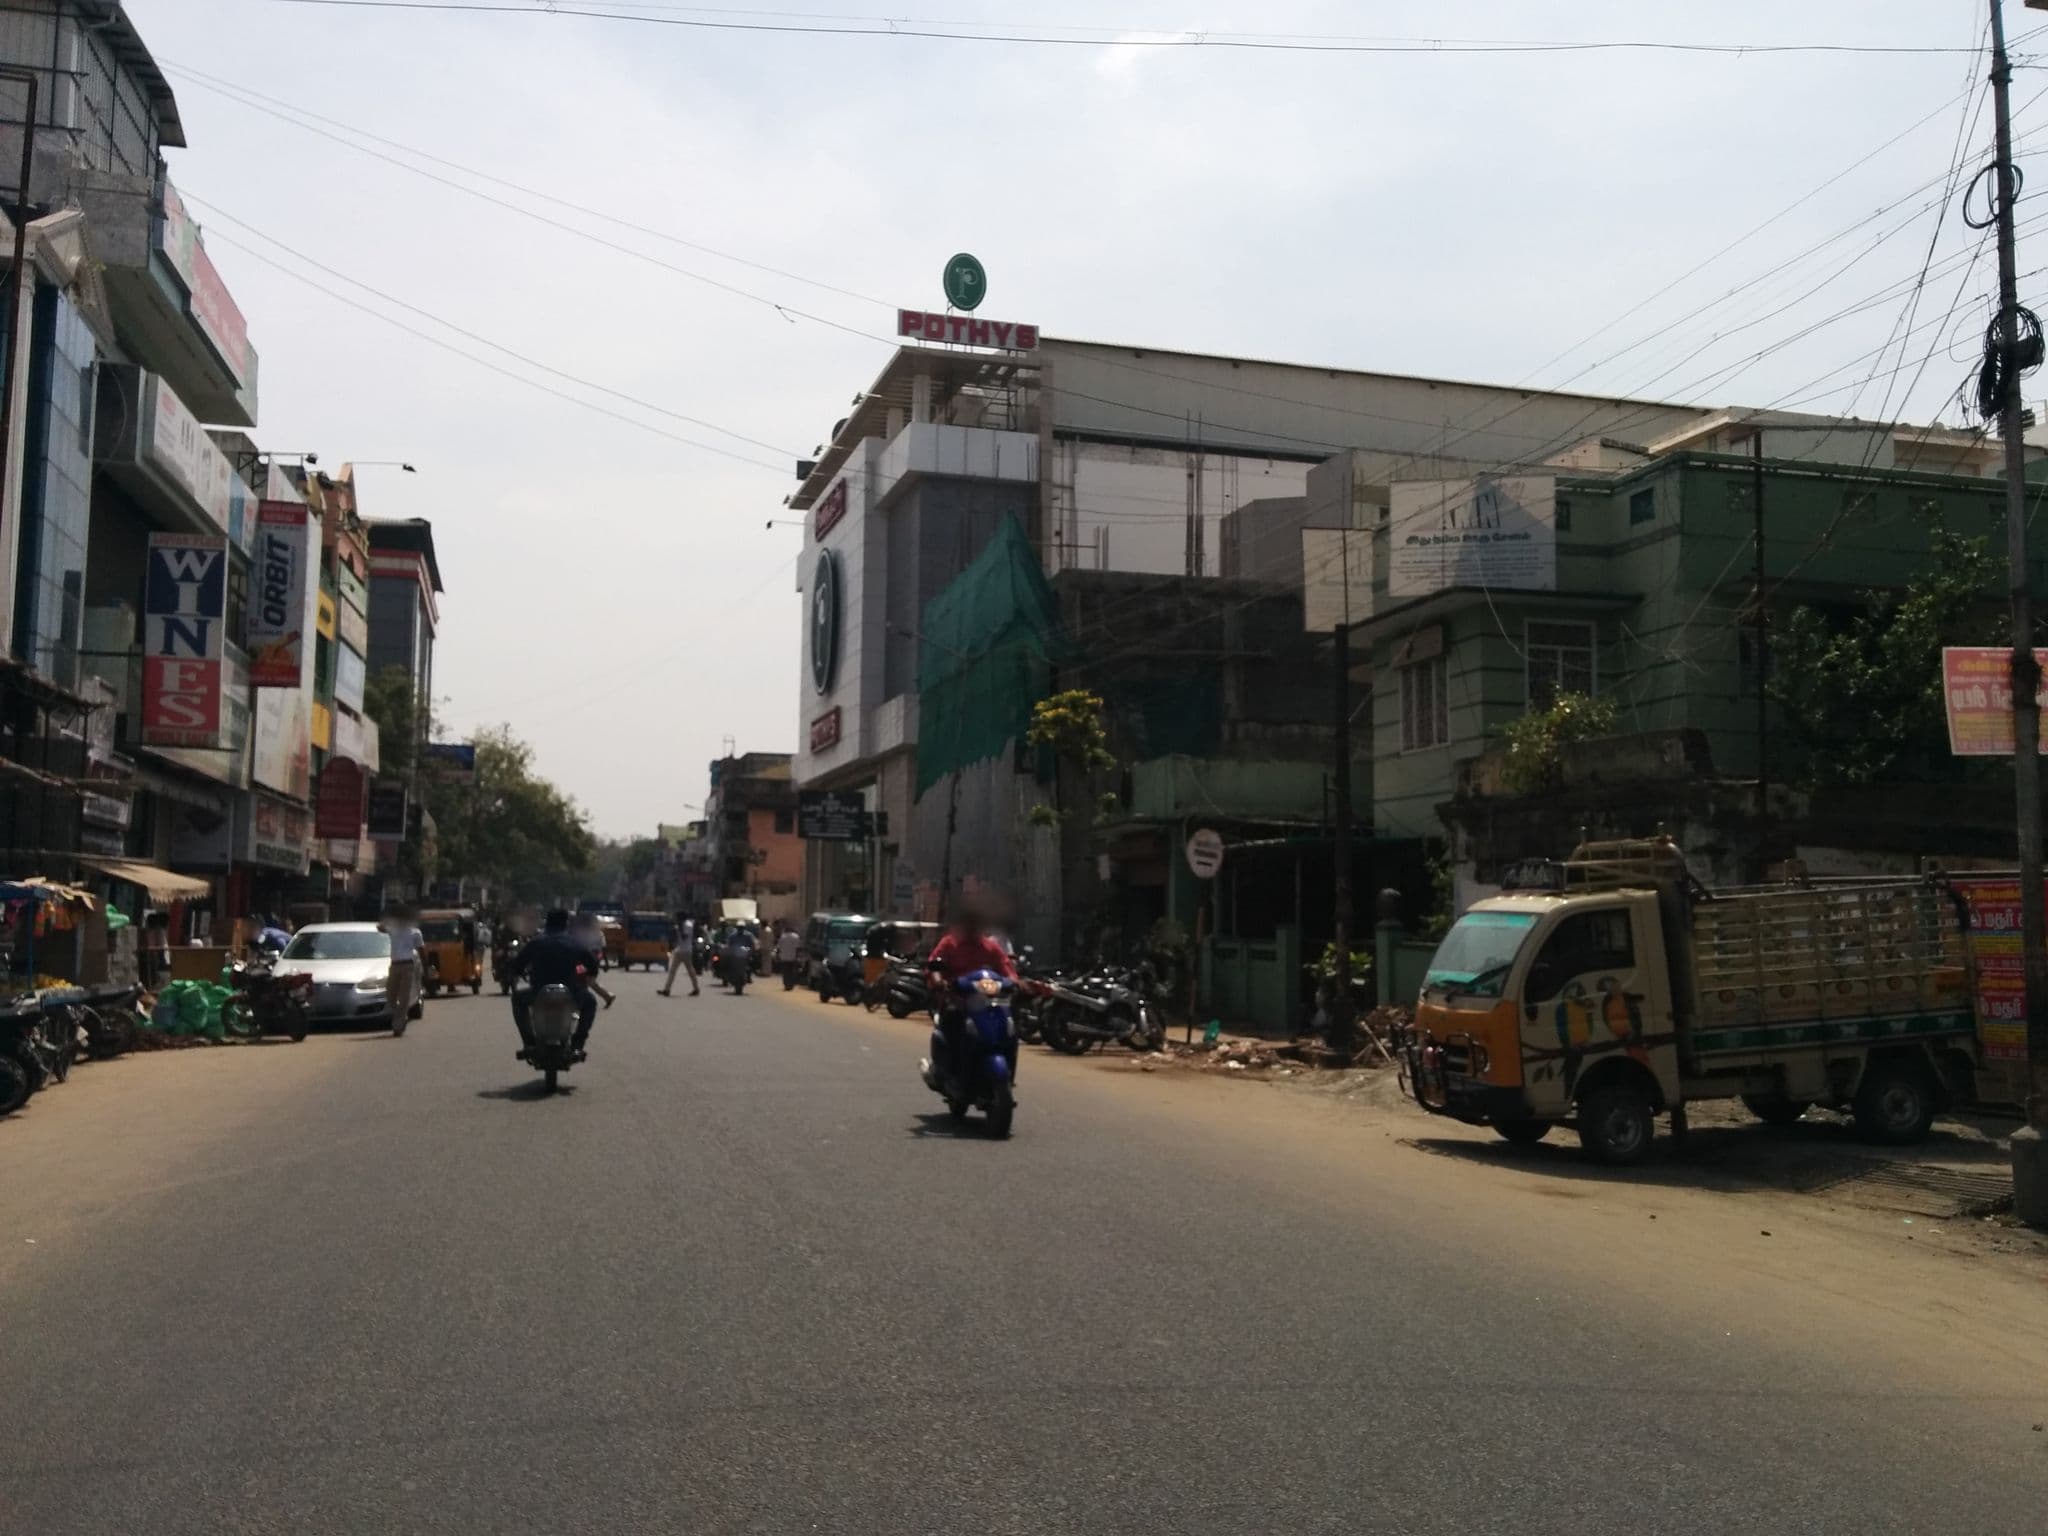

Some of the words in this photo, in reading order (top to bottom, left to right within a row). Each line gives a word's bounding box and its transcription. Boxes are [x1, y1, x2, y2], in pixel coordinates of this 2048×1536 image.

[901, 311, 1037, 350] POTHYS
[263, 533, 291, 628] ORBIT
[157, 548, 219, 728] WINES
